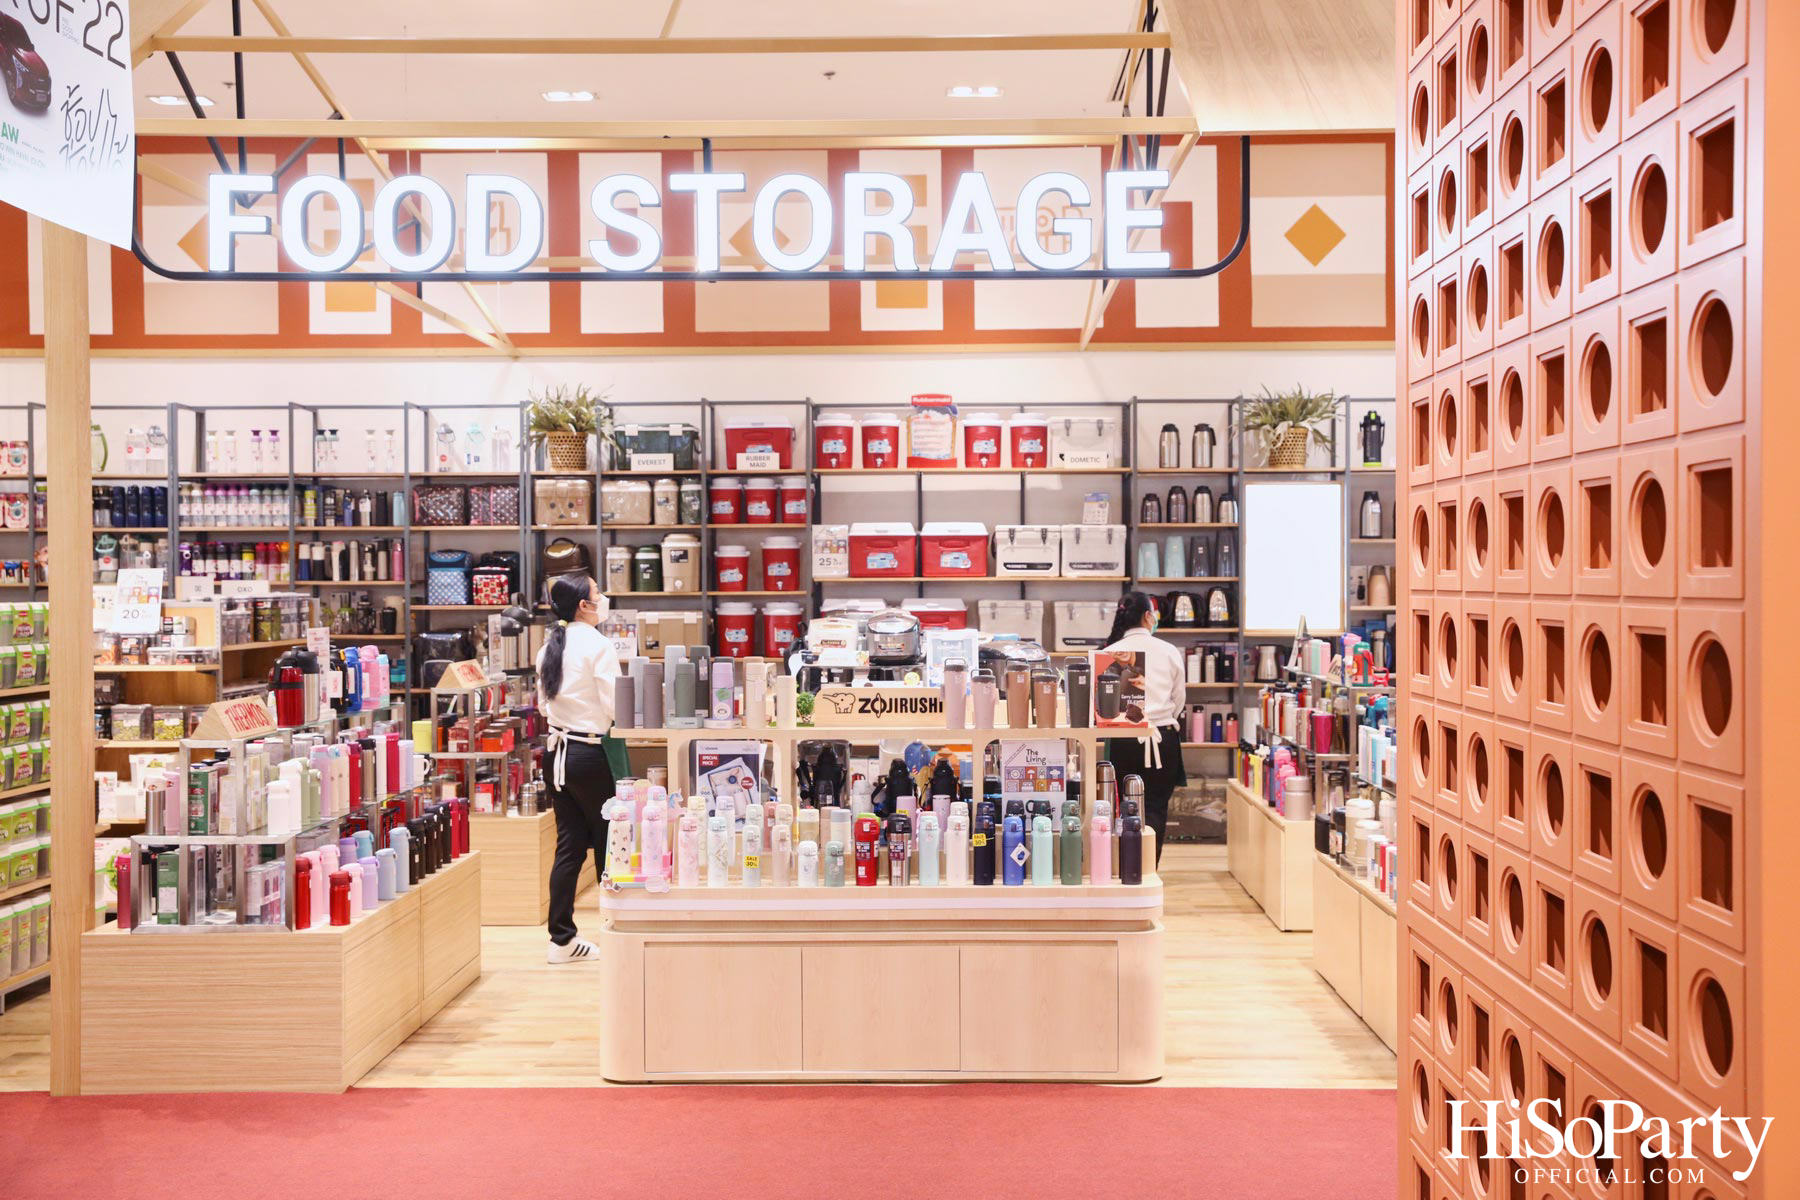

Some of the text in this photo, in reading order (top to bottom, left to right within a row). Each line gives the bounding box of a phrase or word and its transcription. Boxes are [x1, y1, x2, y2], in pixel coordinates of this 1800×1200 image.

[208, 173, 544, 273] FOOD
[588, 171, 1172, 273] STORAGE
[1070, 456, 1101, 464] DOMETIC
[858, 693, 943, 718] ZOJIRUSHI
[1026, 757, 1047, 766] Living
